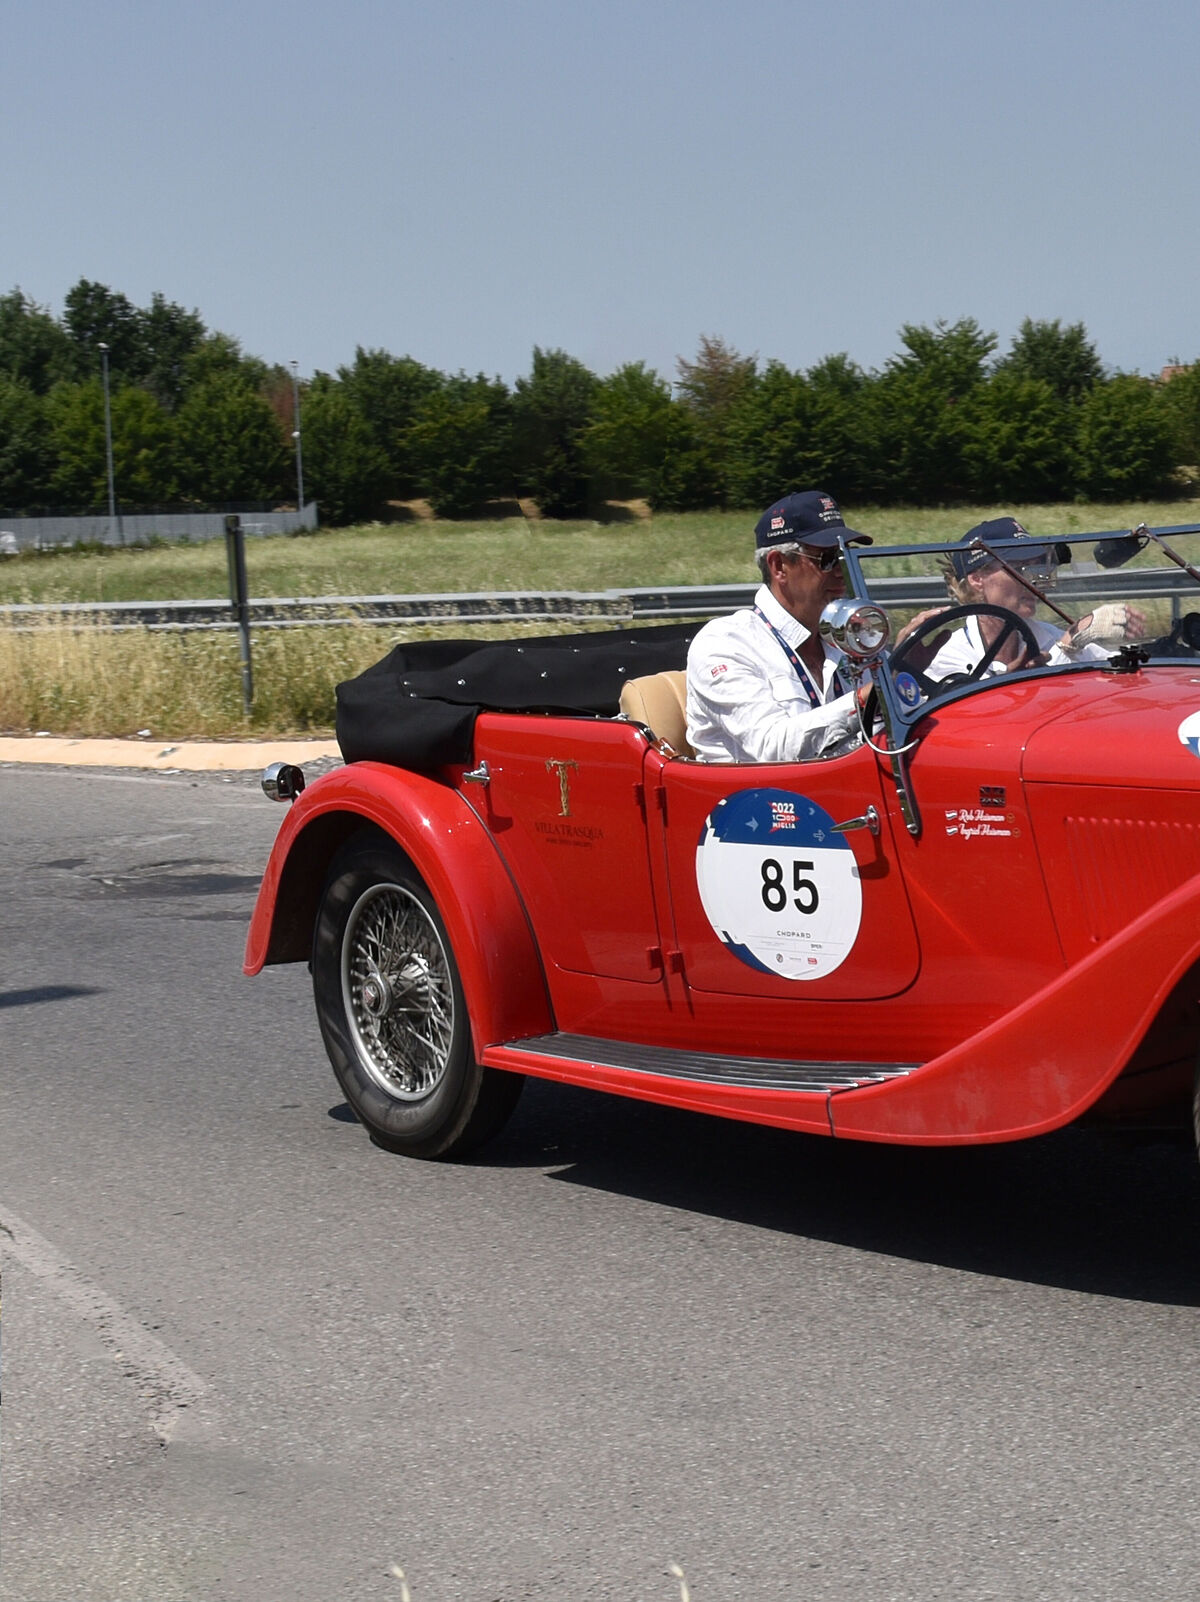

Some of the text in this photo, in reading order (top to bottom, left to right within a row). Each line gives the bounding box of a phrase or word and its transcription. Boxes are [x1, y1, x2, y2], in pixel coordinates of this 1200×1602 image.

[771, 801, 795, 814] 2022
[772, 814, 796, 822] 1000
[772, 821, 796, 829] MIGLIA
[760, 858, 820, 915] 85
[776, 930, 812, 939] CHOPARD
